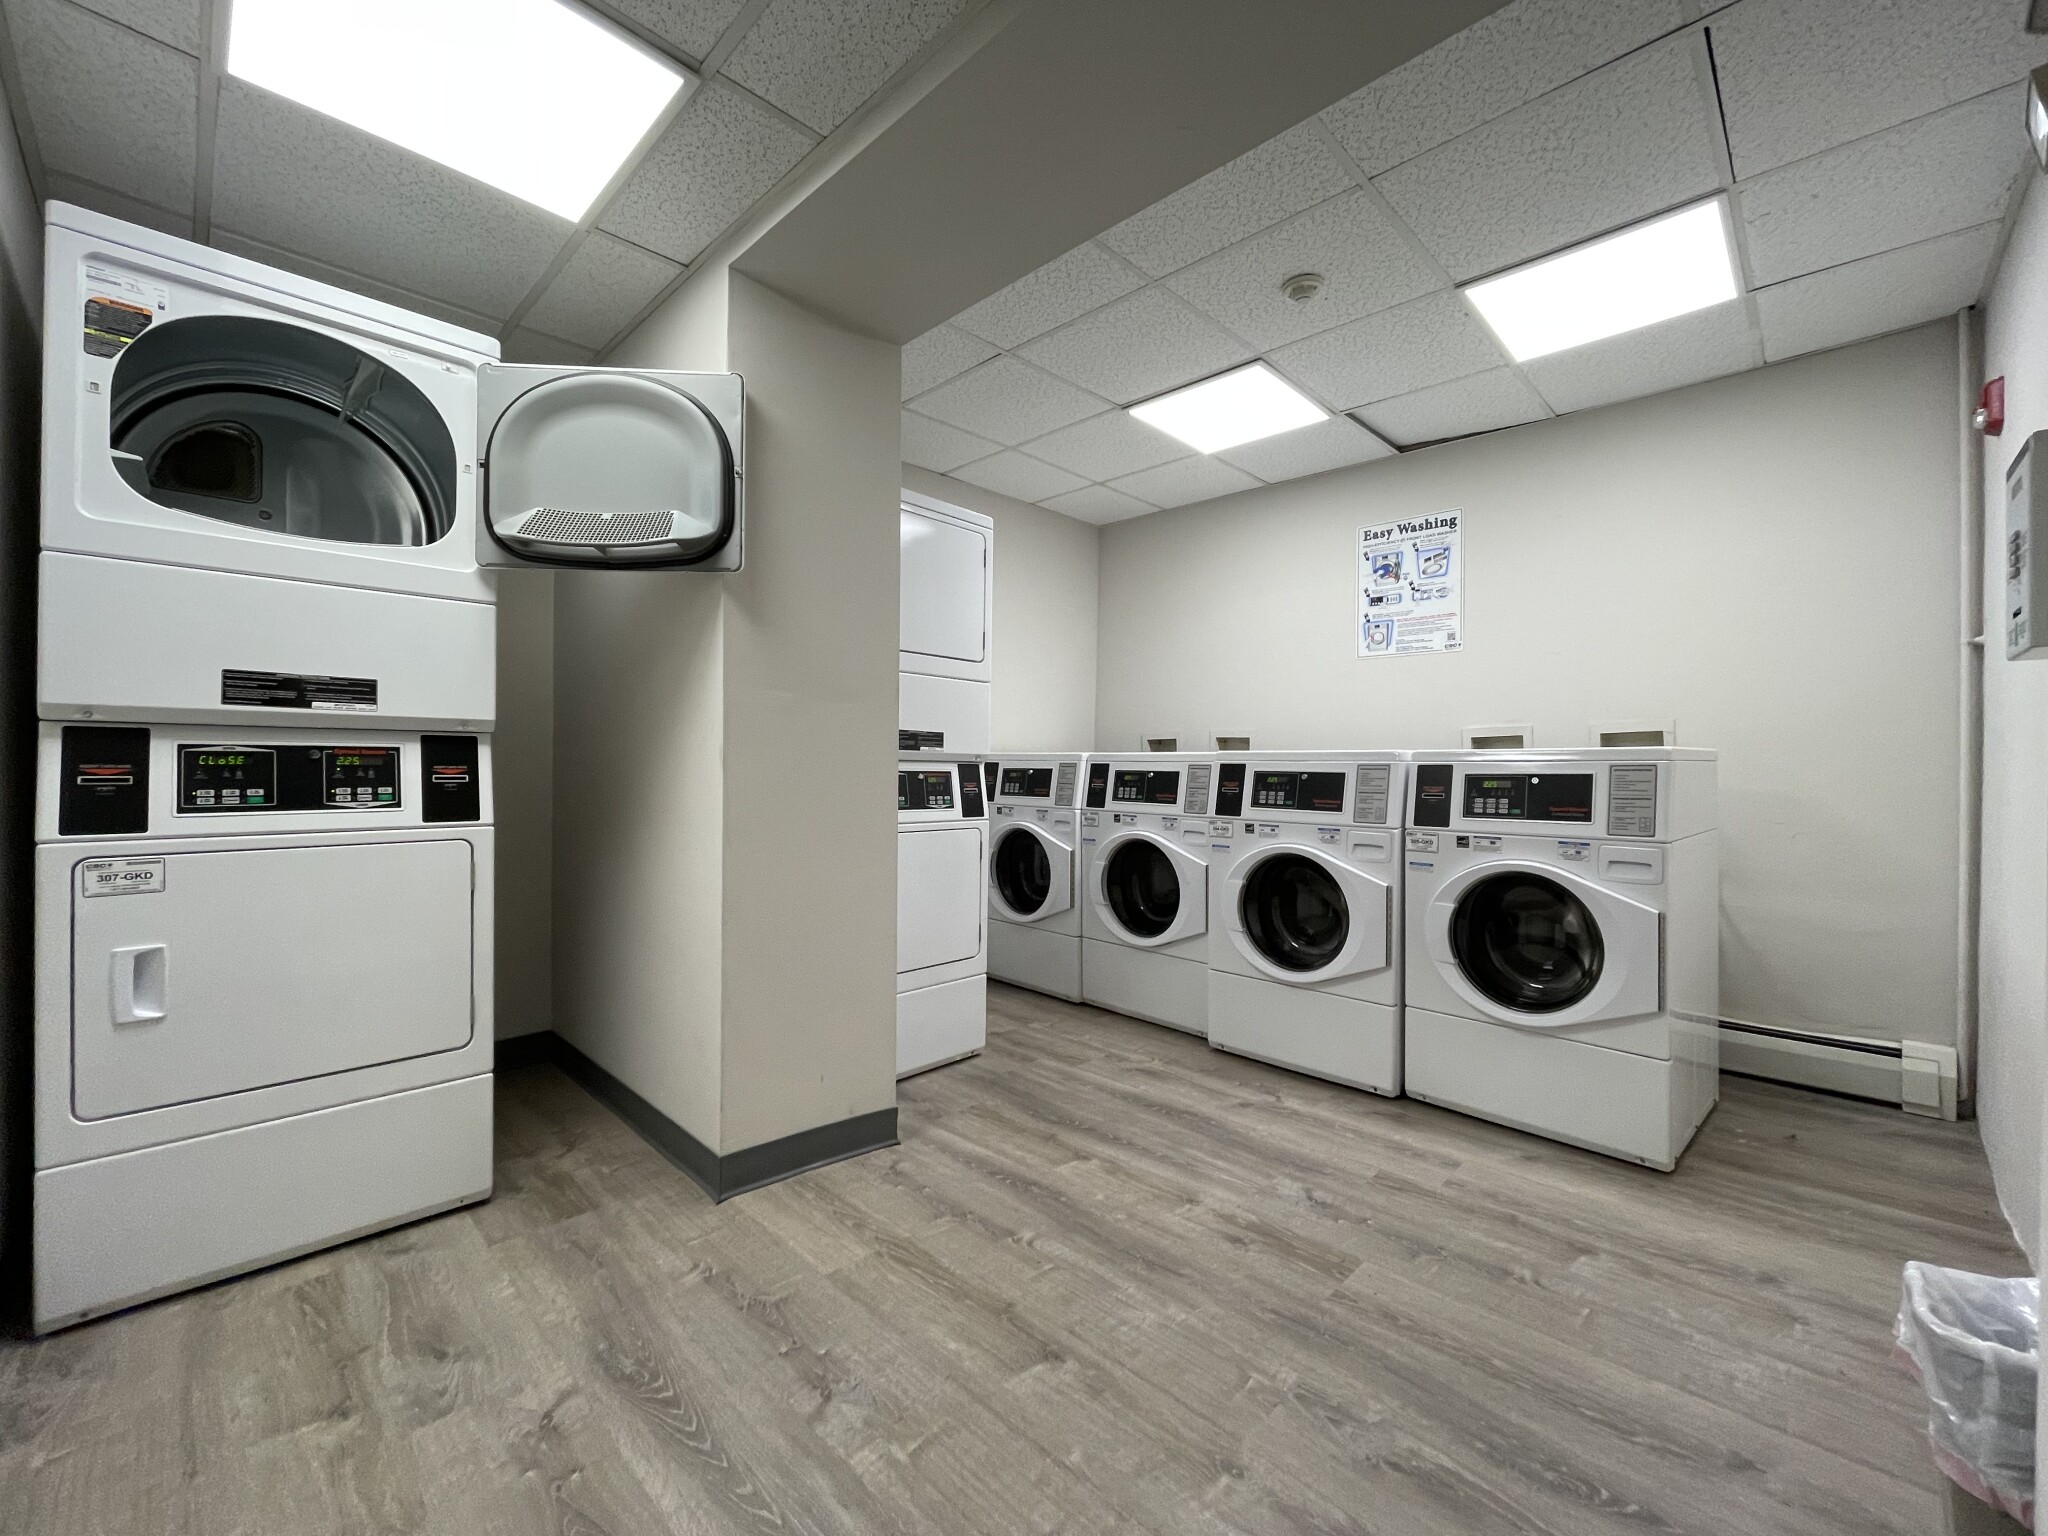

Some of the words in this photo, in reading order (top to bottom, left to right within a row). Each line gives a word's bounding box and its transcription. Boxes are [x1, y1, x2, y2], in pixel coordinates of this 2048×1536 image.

[1363, 529, 1394, 542] Easy
[1397, 517, 1458, 536] Washing
[97, 871, 154, 883] 307-GKD
